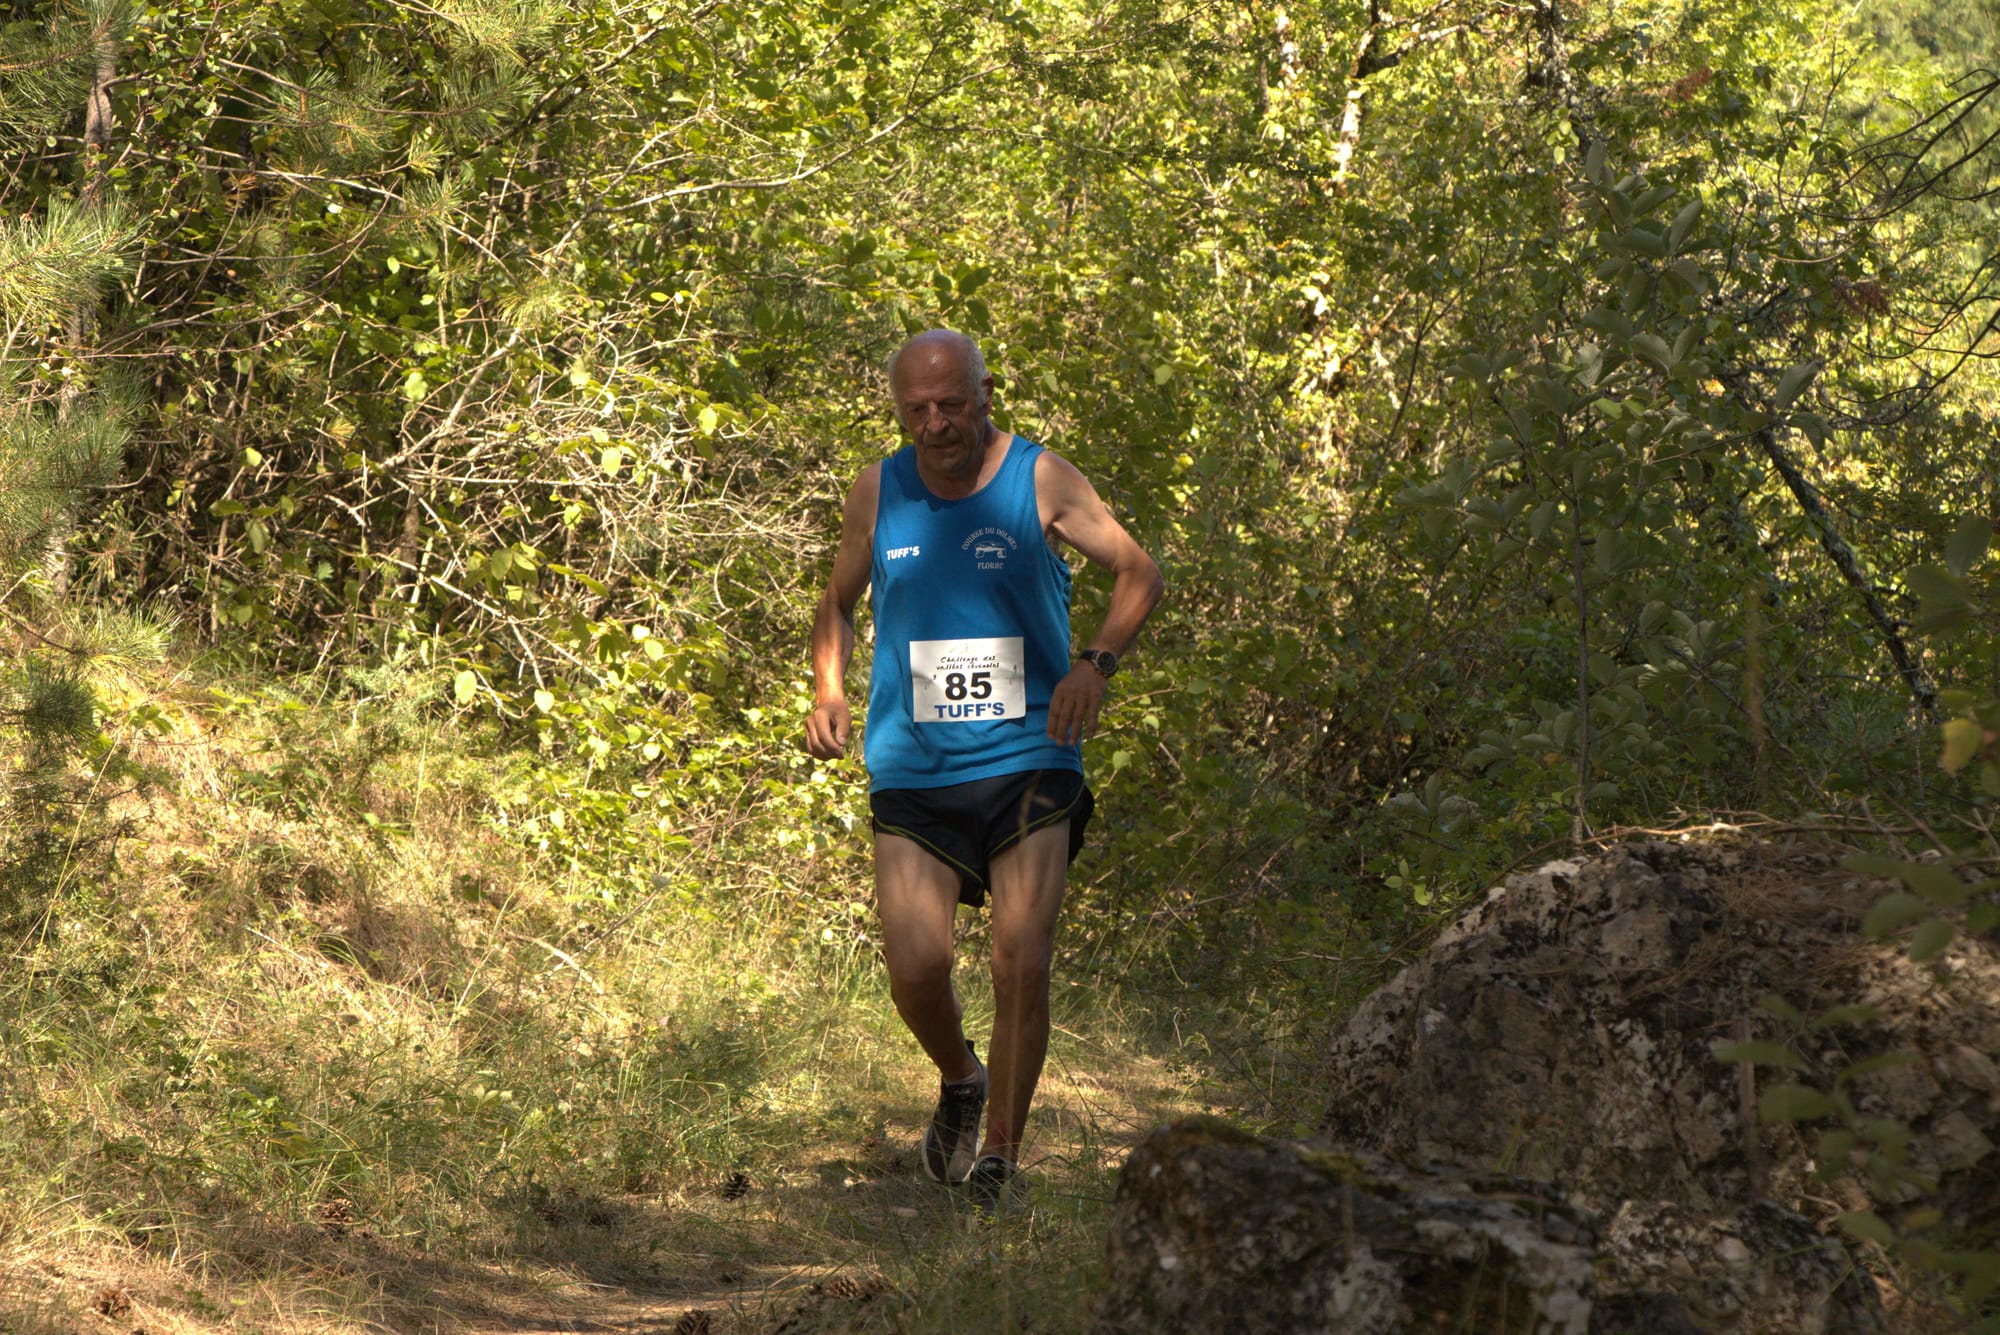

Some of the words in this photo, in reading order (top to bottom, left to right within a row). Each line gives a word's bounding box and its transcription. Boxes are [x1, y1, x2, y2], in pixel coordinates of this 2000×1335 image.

[961, 528, 984, 550] COURSE
[984, 527, 995, 535] DU
[886, 545, 920, 560] TUFF'S
[940, 656, 978, 664] Challenge
[945, 671, 993, 700] 85
[934, 702, 1005, 718] TUFF'S
